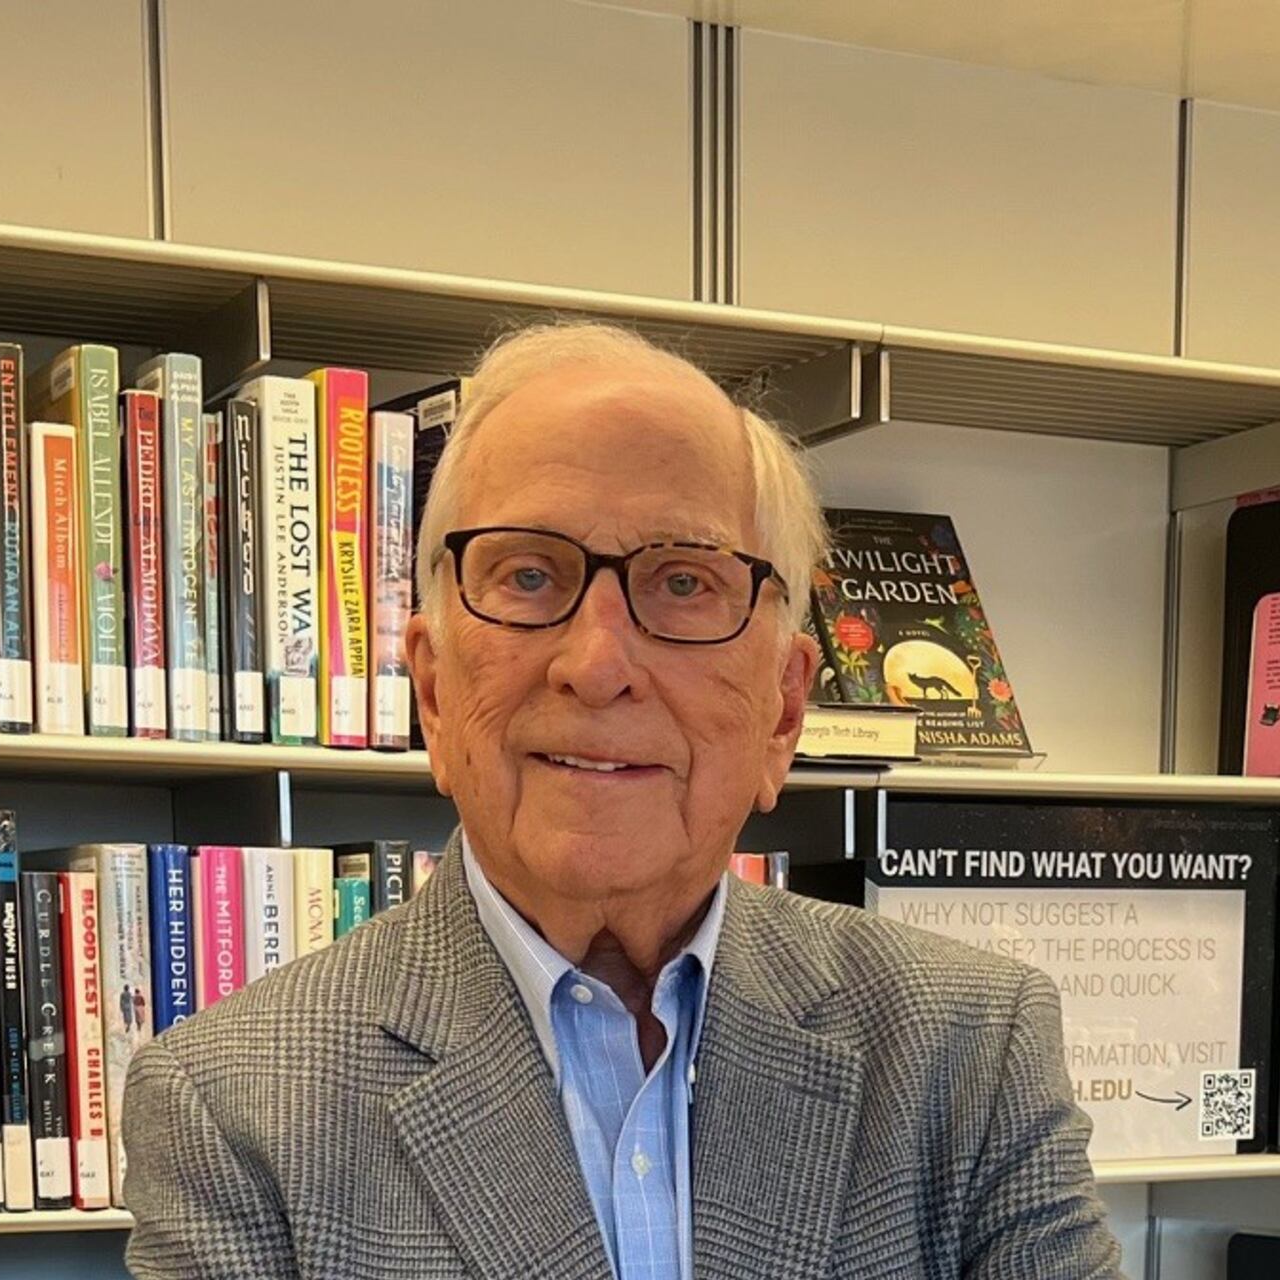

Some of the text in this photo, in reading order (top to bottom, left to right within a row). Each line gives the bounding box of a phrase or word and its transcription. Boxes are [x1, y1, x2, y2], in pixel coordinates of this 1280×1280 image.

[89, 368, 116, 555] ISABEL ALLENDE
[335, 405, 364, 514] ROOTLESS
[53, 457, 68, 569] Mitch Albom
[289, 434, 312, 578] THE LOST
[873, 535, 892, 546] THE
[823, 547, 957, 576] TWILIGHT
[841, 578, 959, 605] GARDEN
[804, 726, 830, 738] eorgia
[925, 719, 985, 729] READING LIST
[919, 730, 1023, 746] NISHA ADAMS
[879, 848, 1253, 880] CAN'T FIND WHAT YOU WANT?
[900, 902, 1139, 926] WHY NOT SUGGEST A
[167, 869, 187, 1007] HER HIDDEN
[1041, 937, 1085, 962] THE
[1092, 938, 1192, 961] PROCESS
[1197, 939, 1216, 961] IS
[1060, 973, 1104, 998] AND
[1177, 1041, 1228, 1065] VISIT
